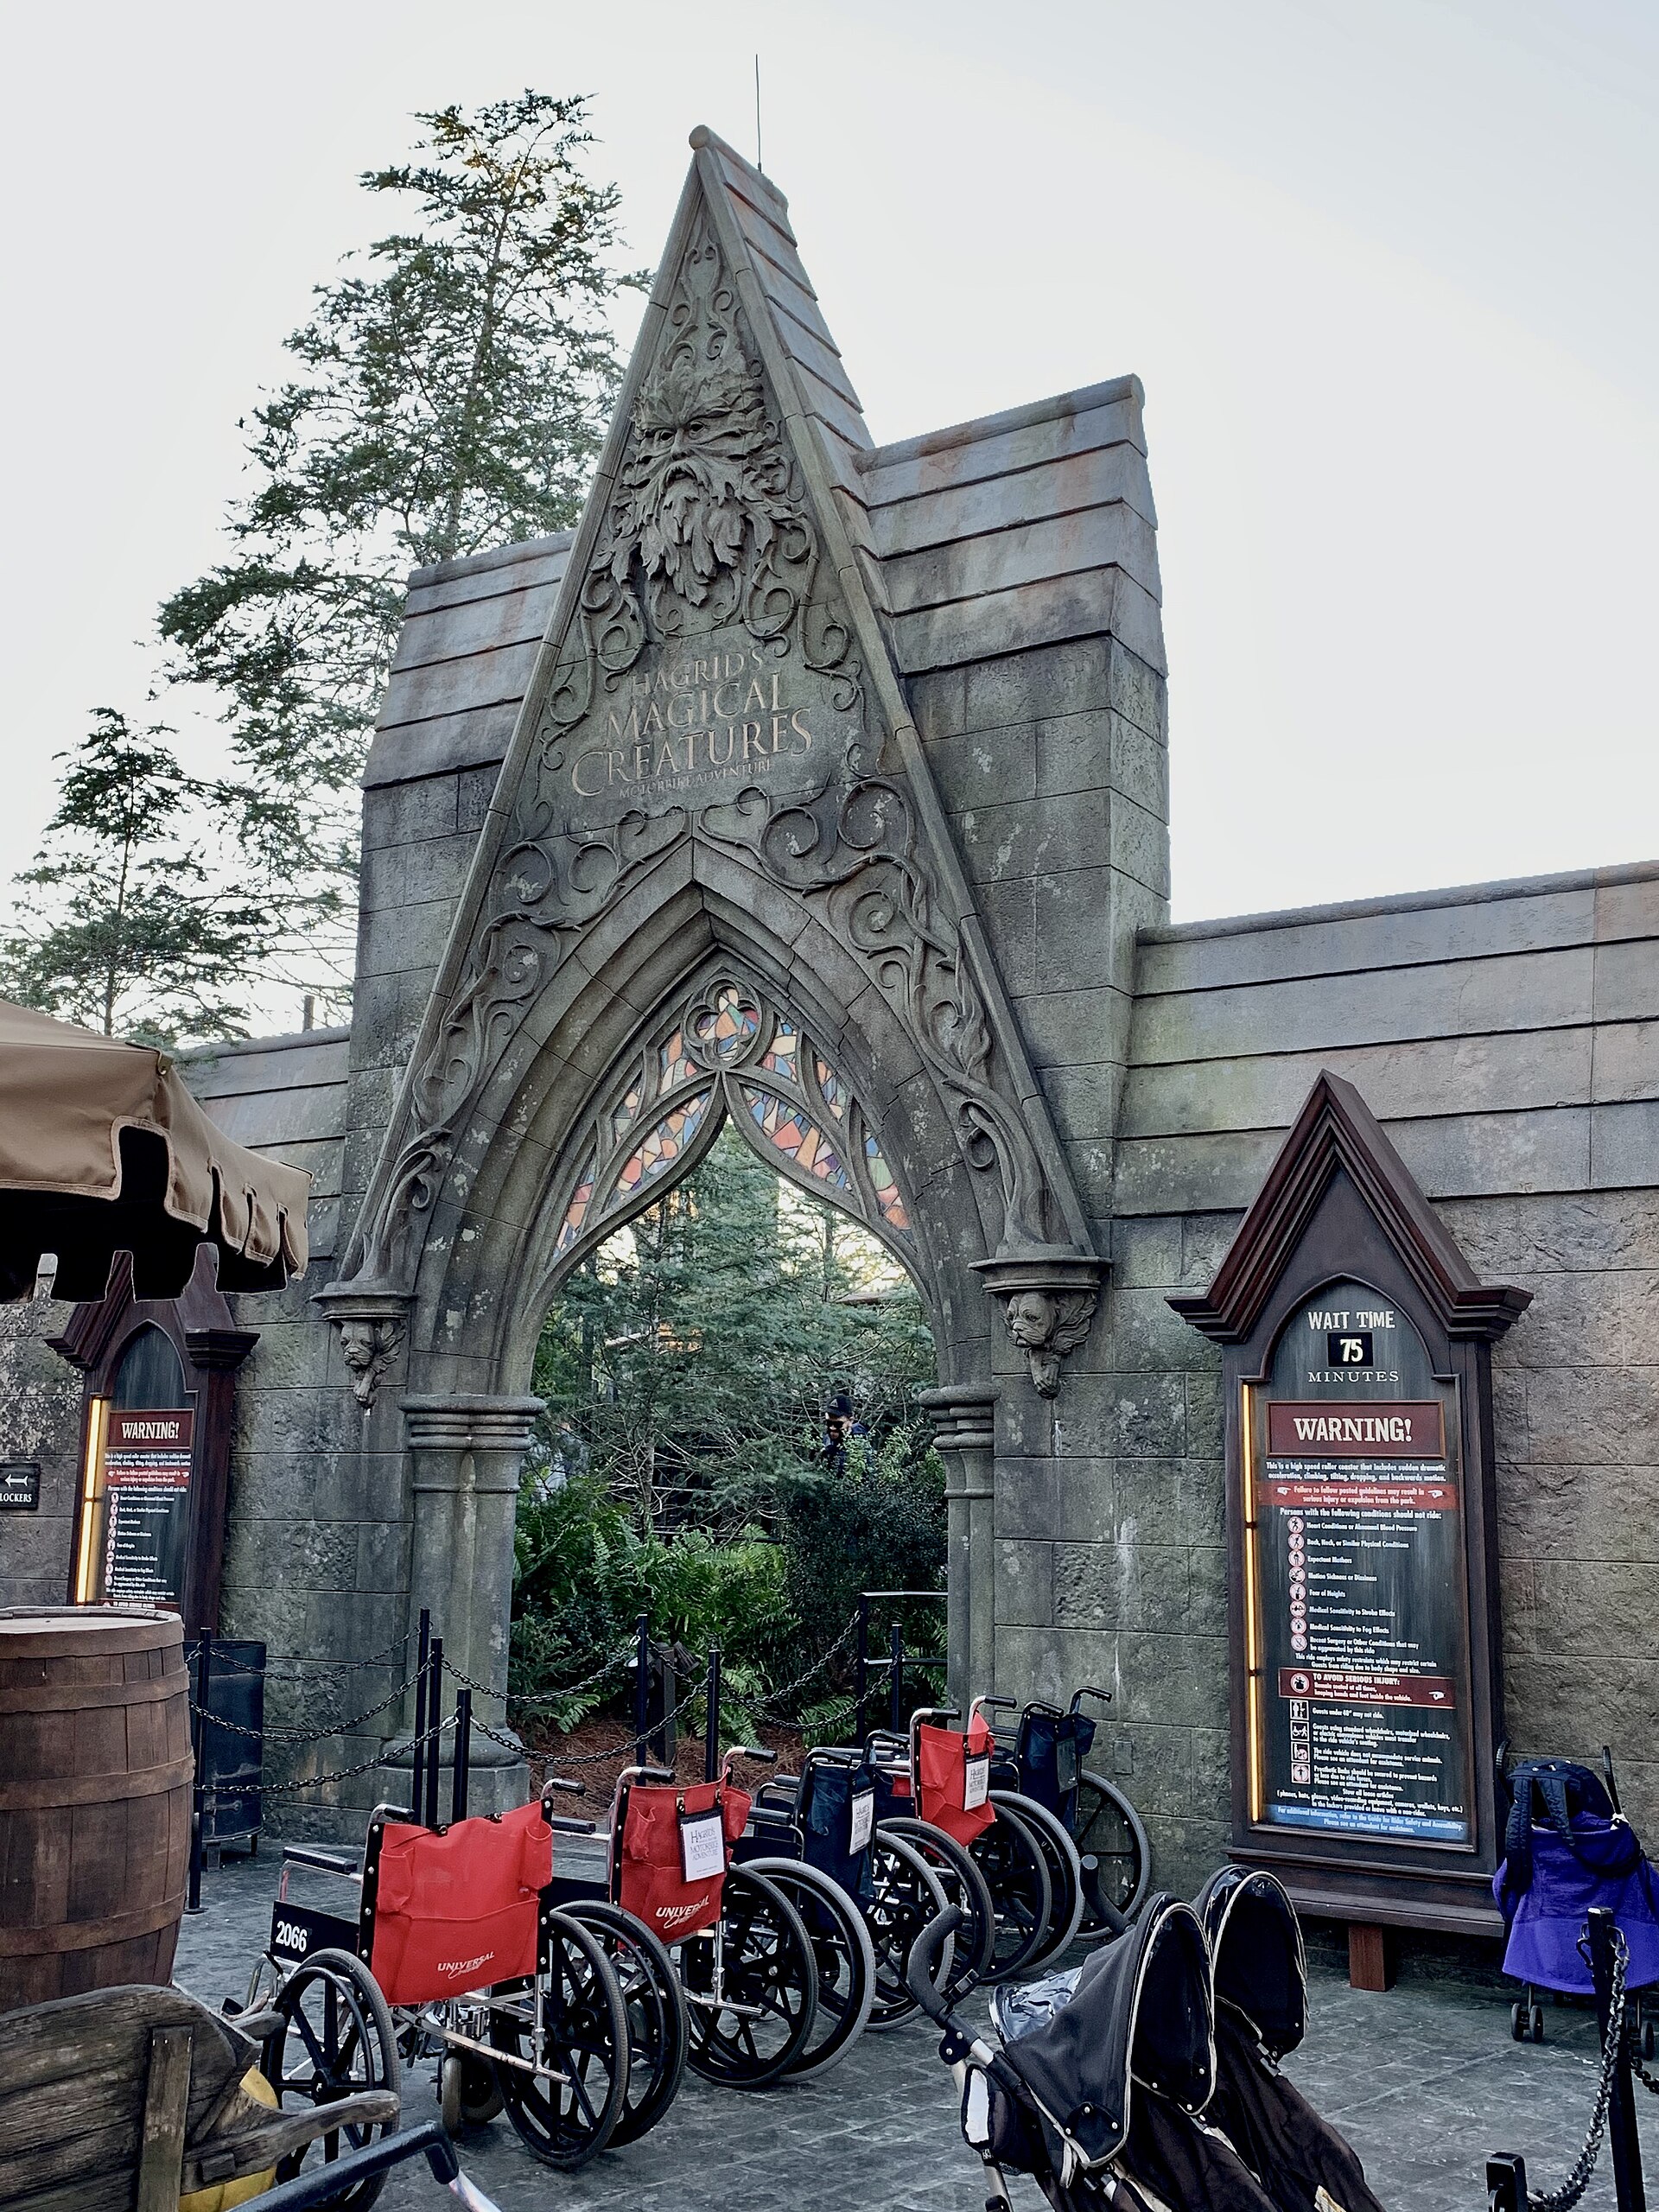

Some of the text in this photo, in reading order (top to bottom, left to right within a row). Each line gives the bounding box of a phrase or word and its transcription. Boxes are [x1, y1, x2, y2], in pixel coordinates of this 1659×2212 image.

[607, 672, 790, 746] MAGICAL
[571, 707, 812, 797] CREATURES
[620, 759, 771, 798] MOTORBIKE ADVENTURE
[1308, 1310, 1395, 1330] WAIT TIME
[1339, 1338, 1363, 1362] 75
[1307, 1371, 1399, 1382] MINUTES
[121, 1421, 180, 1440] WARNING!
[1294, 1417, 1413, 1442] WARNING!
[1290, 1462, 1302, 1471] high
[0, 1492, 33, 1503] LOCKERS
[1331, 1509, 1359, 1518] following
[1361, 1509, 1391, 1517] conditions
[1313, 1672, 1321, 1680] TO
[1323, 1673, 1343, 1681] AVOID
[1345, 1674, 1372, 1683] SERIOUS
[276, 1921, 308, 1952] 2066
[437, 1951, 495, 1971] UNIVERSAL
